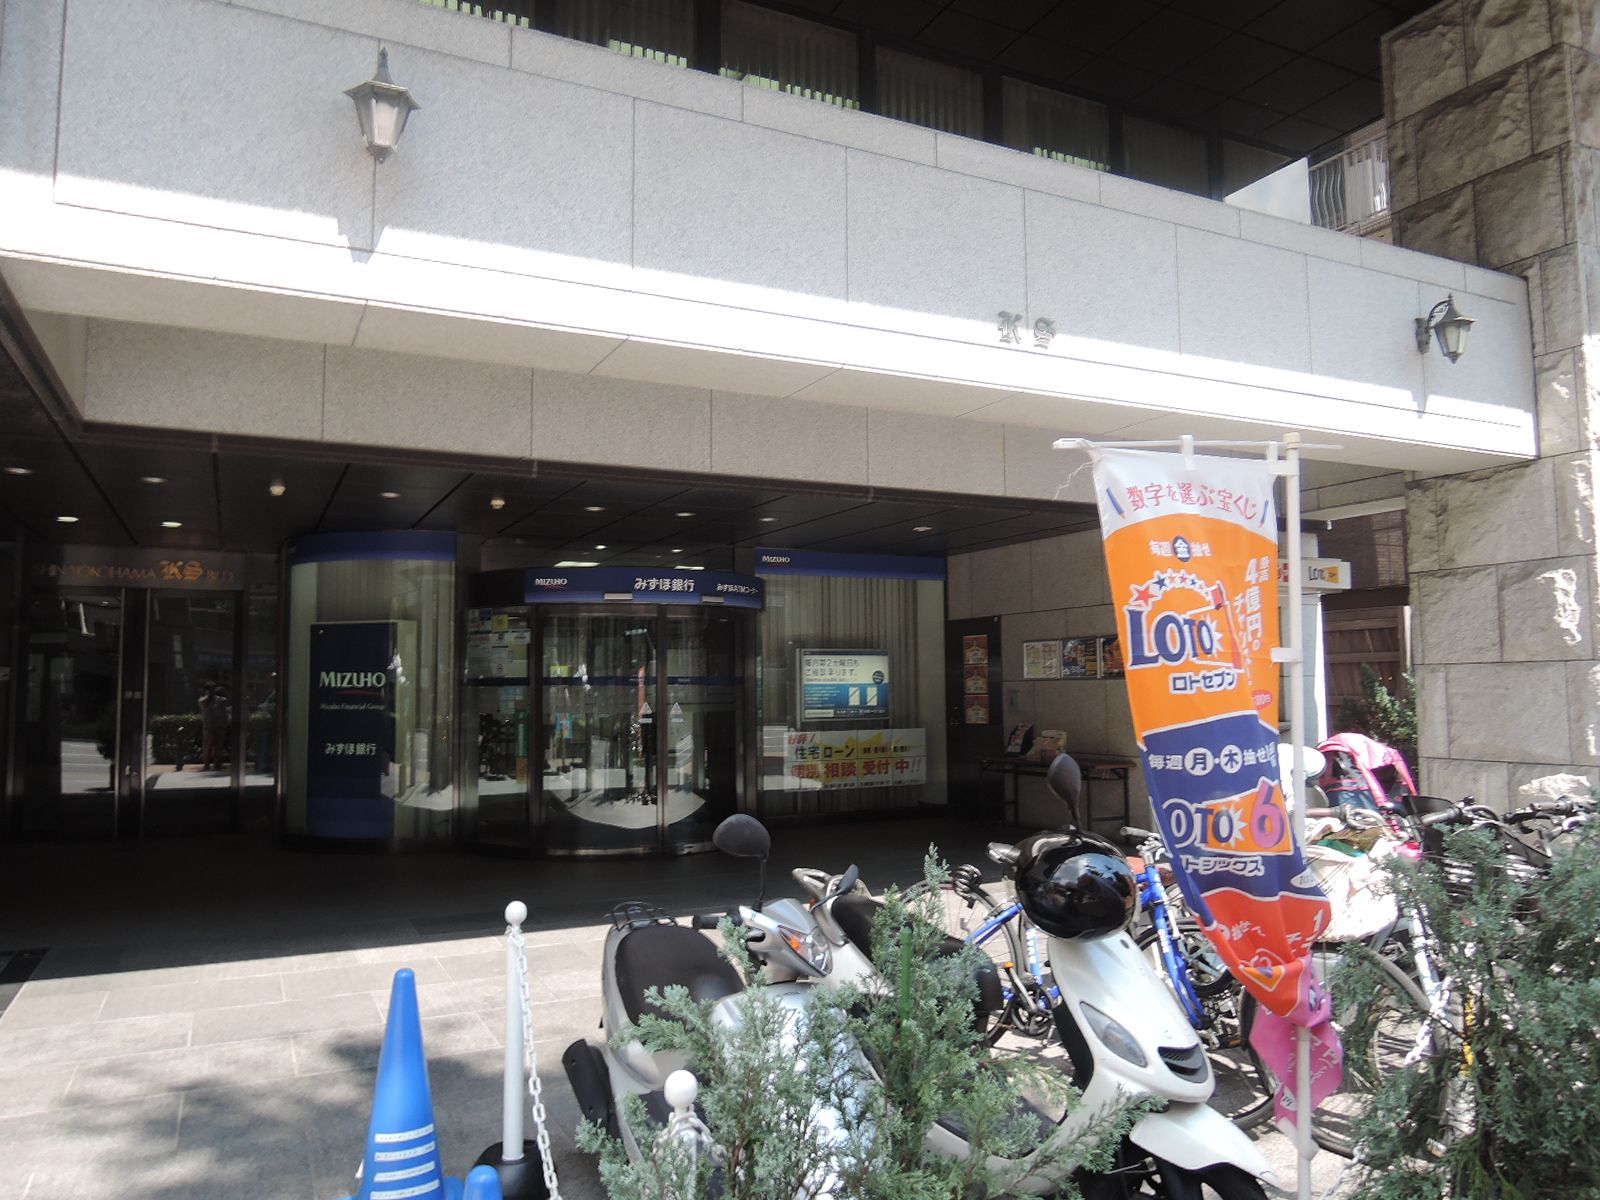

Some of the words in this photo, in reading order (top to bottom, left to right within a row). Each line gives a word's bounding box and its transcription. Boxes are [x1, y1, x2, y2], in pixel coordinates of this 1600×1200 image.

[997, 310, 1056, 350] KS
[1126, 481, 1257, 519] 数字を選ぶ宝くじ
[761, 555, 790, 564] MIZUHO
[158, 559, 204, 583] KS
[535, 578, 568, 587] MIZUHO
[633, 577, 696, 593] みずほ銀行
[319, 671, 386, 687] MIZUHO
[1172, 671, 1236, 691] ロトセブン
[324, 743, 377, 756] みずほ銀行
[795, 745, 855, 760] 住宅ローン
[1181, 856, 1264, 876] トシックス
